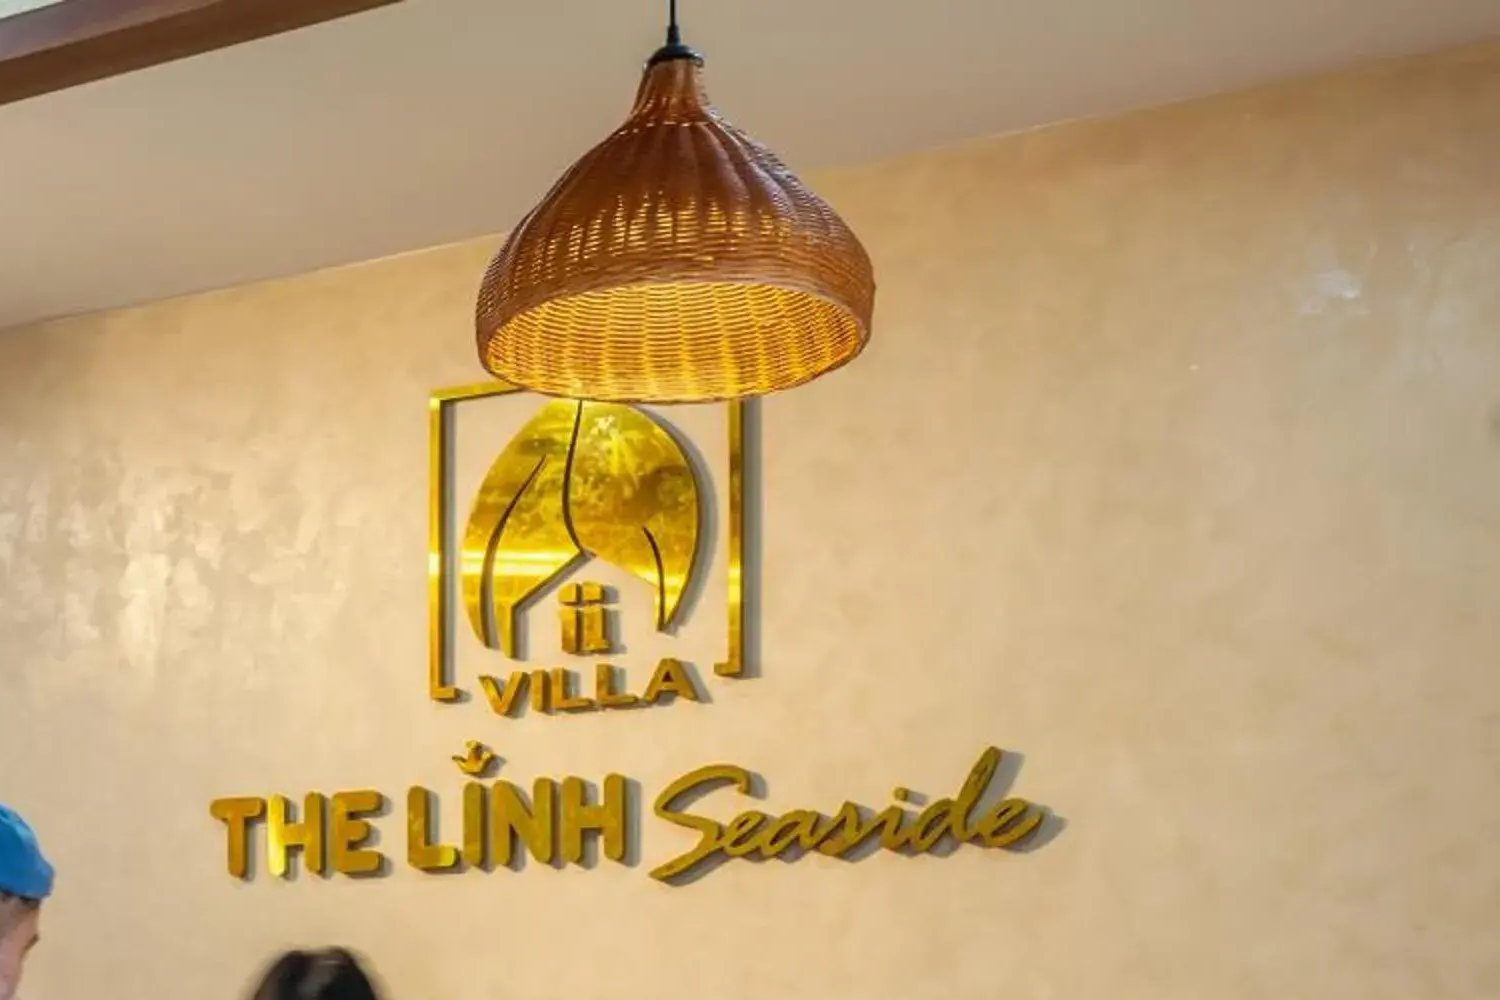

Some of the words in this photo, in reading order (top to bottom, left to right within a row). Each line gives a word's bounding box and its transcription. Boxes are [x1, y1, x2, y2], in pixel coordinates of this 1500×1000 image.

[478, 658, 699, 716] VILLA
[209, 790, 383, 877] THE
[648, 745, 1042, 882] Seaside
